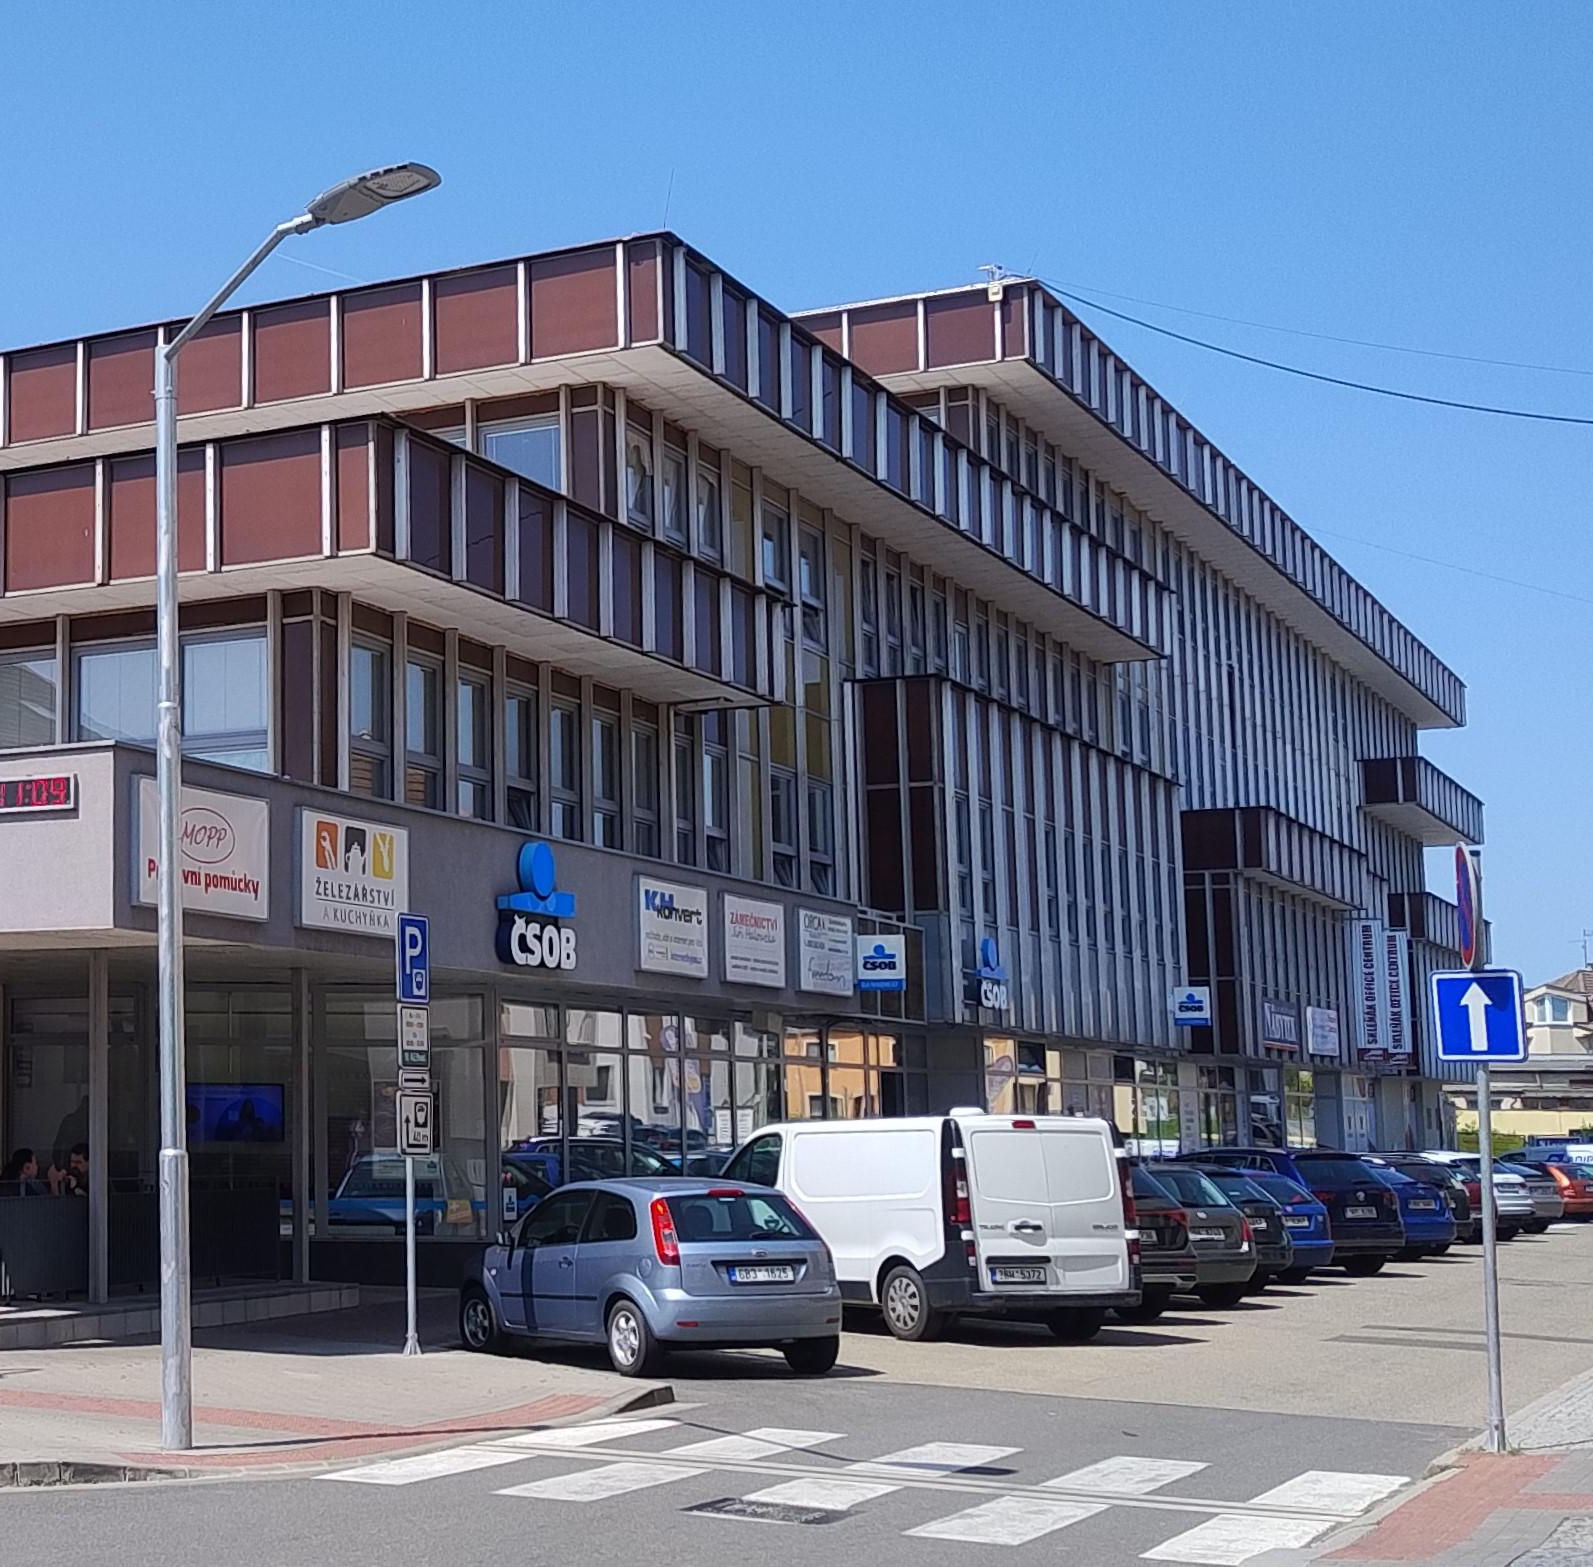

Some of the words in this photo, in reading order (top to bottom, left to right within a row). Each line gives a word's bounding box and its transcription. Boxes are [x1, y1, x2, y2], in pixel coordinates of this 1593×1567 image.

[181, 821, 228, 849] MOPP
[148, 857, 202, 886] Pvní
[204, 869, 259, 901] pomůcky
[315, 876, 395, 906] ŽELEZÁŘSTVÍ
[645, 888, 675, 911] KH
[333, 909, 390, 929] KUCHYŇKA
[405, 926, 422, 974] P
[511, 913, 577, 970] ČSOB
[1361, 924, 1375, 969] CENTRUM
[1386, 934, 1400, 978] CENTRUM
[981, 979, 1008, 1009] ČSOB
[1364, 971, 1377, 1002] OFFICE
[1389, 979, 1401, 1009] OFFICE
